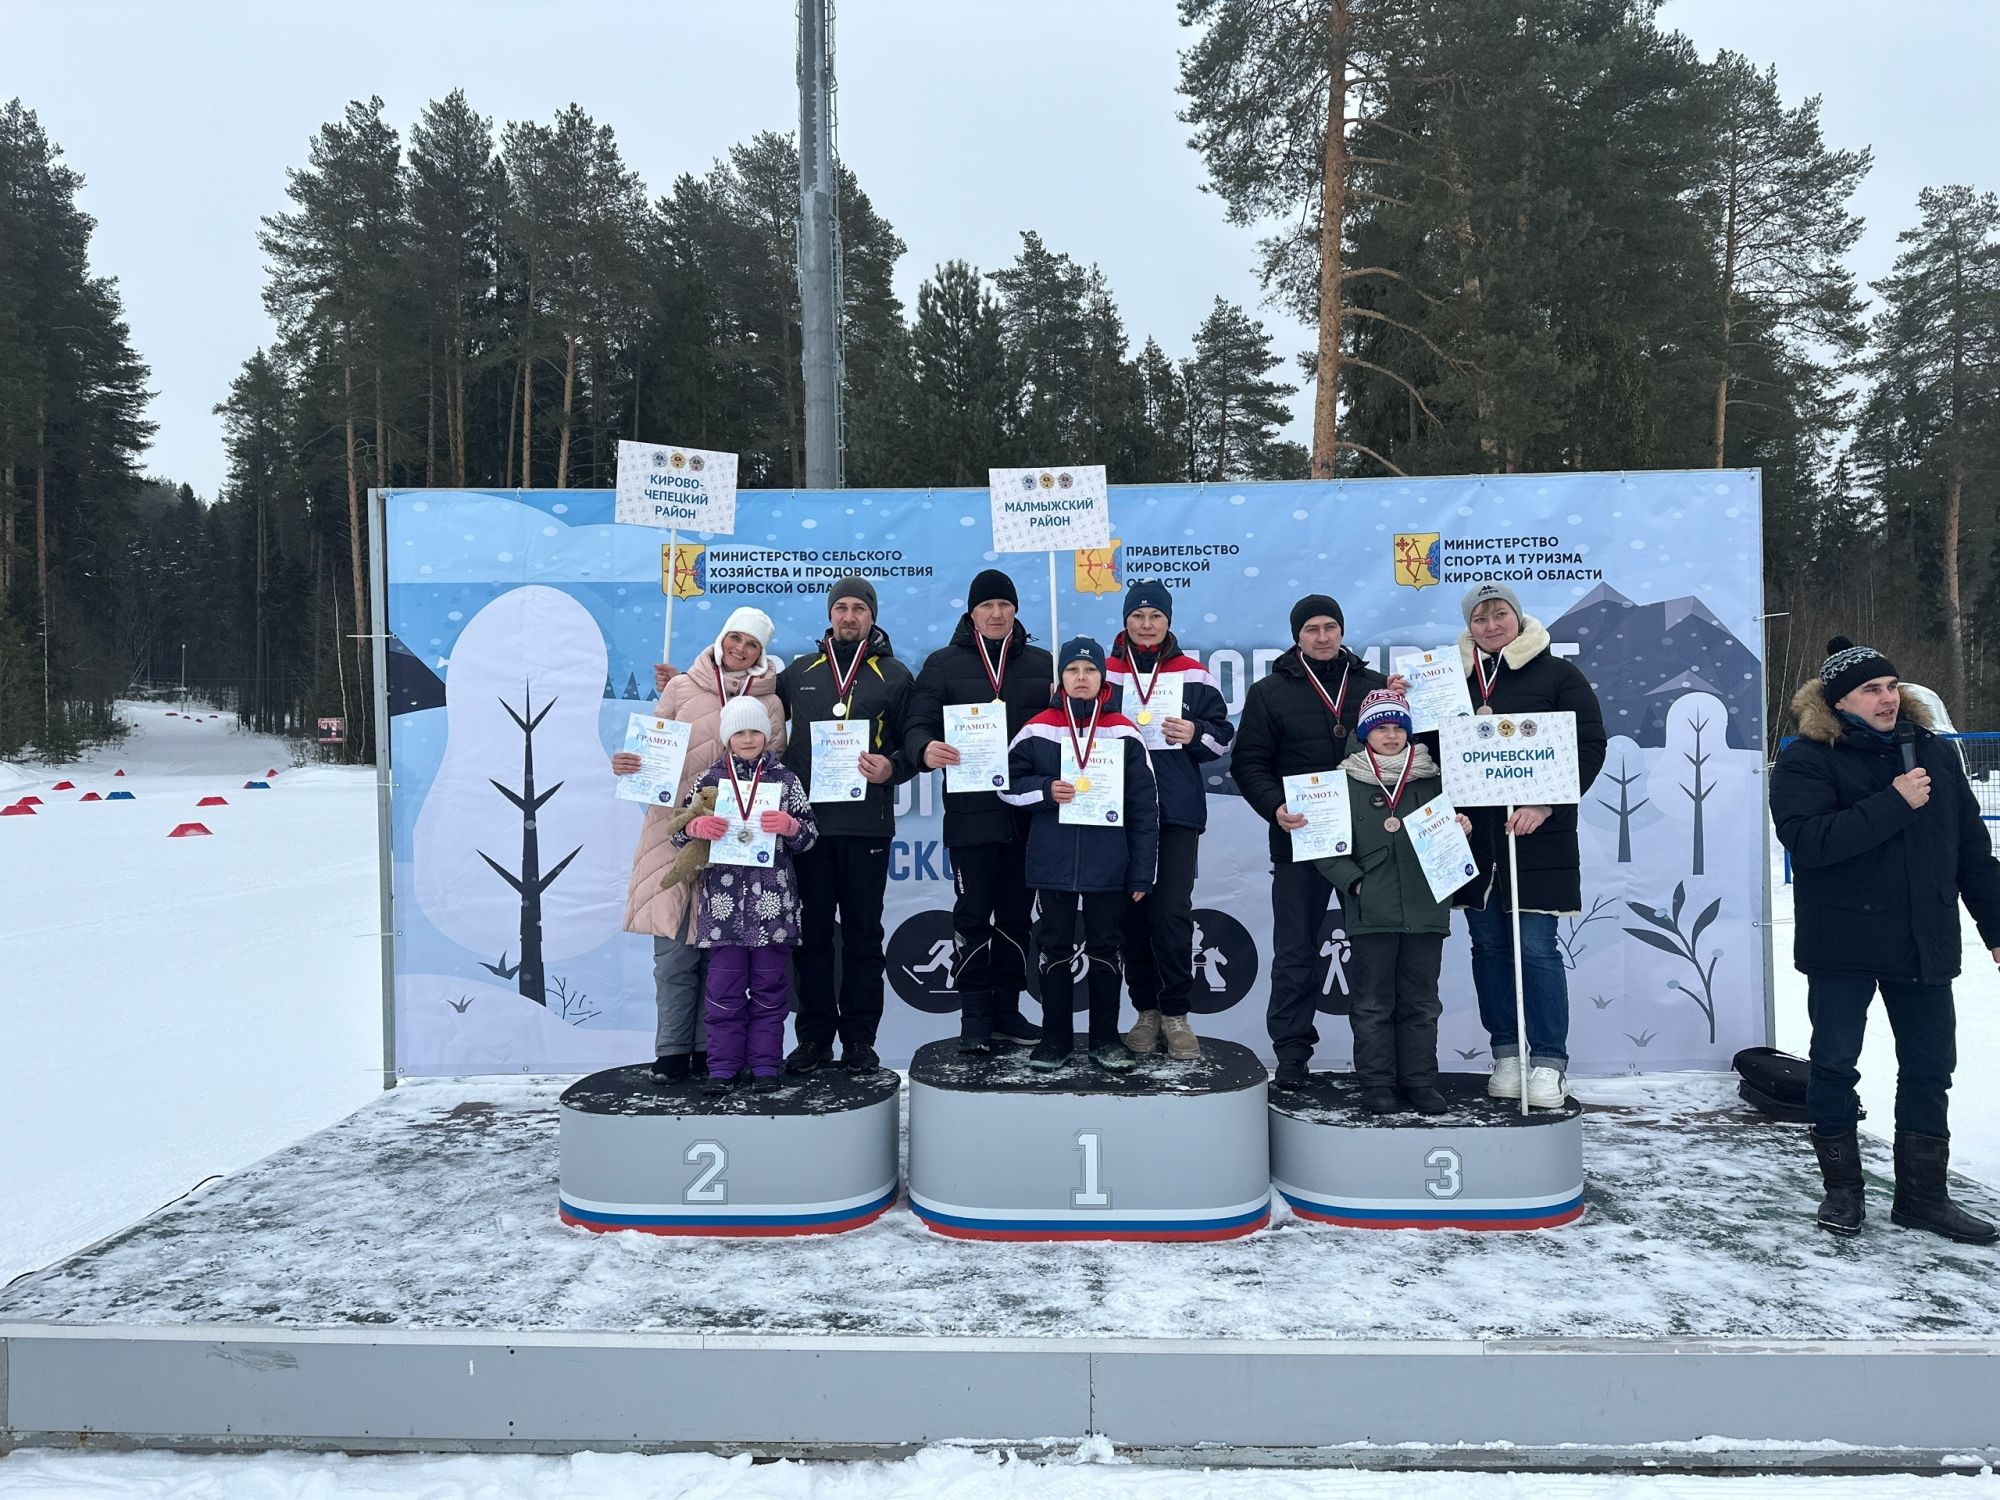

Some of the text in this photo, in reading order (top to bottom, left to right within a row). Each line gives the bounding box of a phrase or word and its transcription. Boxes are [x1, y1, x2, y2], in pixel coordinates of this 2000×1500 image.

[650, 474, 704, 489] КИРОВО-
[644, 489, 708, 505] ЧЕПЕЦКИЙ
[1005, 497, 1094, 512] МАЛМЫЖСКИЙ
[655, 505, 696, 519] РАЙОН
[1030, 514, 1071, 527] РАЙОН
[1444, 536, 1559, 550] МИНИСТЕРСТВО
[710, 551, 902, 561] МИНИСТЕРСТВО СЕЛЬСКОГО
[1126, 545, 1240, 556] ПРАВИТЕЛЬСТВО
[1126, 559, 1210, 572] КИРОВСКОЙ
[1444, 553, 1582, 566] СПОРТА И ТУРИЗМА
[710, 565, 933, 578] ХОЗЯЙСТВА И ПРОДОВОЛЬСТВИЯ
[1444, 568, 1602, 583] КИРОВСКОЙ ОБЛАСТИ
[710, 581, 793, 594] КИРОВСКОЙ
[1409, 667, 1454, 681] ГРАМОТА
[954, 722, 998, 732] ГРАМОТА
[635, 734, 678, 747] ГРАМОТА
[1462, 747, 1555, 763] ОРИЧЕВСКИЙ
[1486, 765, 1533, 779] РАЙОН
[1296, 790, 1339, 801] ГРАМОТА
[1418, 815, 1450, 839] ГРАМОТА
[682, 1139, 729, 1205] 2
[1070, 1128, 1112, 1210] 1
[1424, 1146, 1463, 1200] 3
